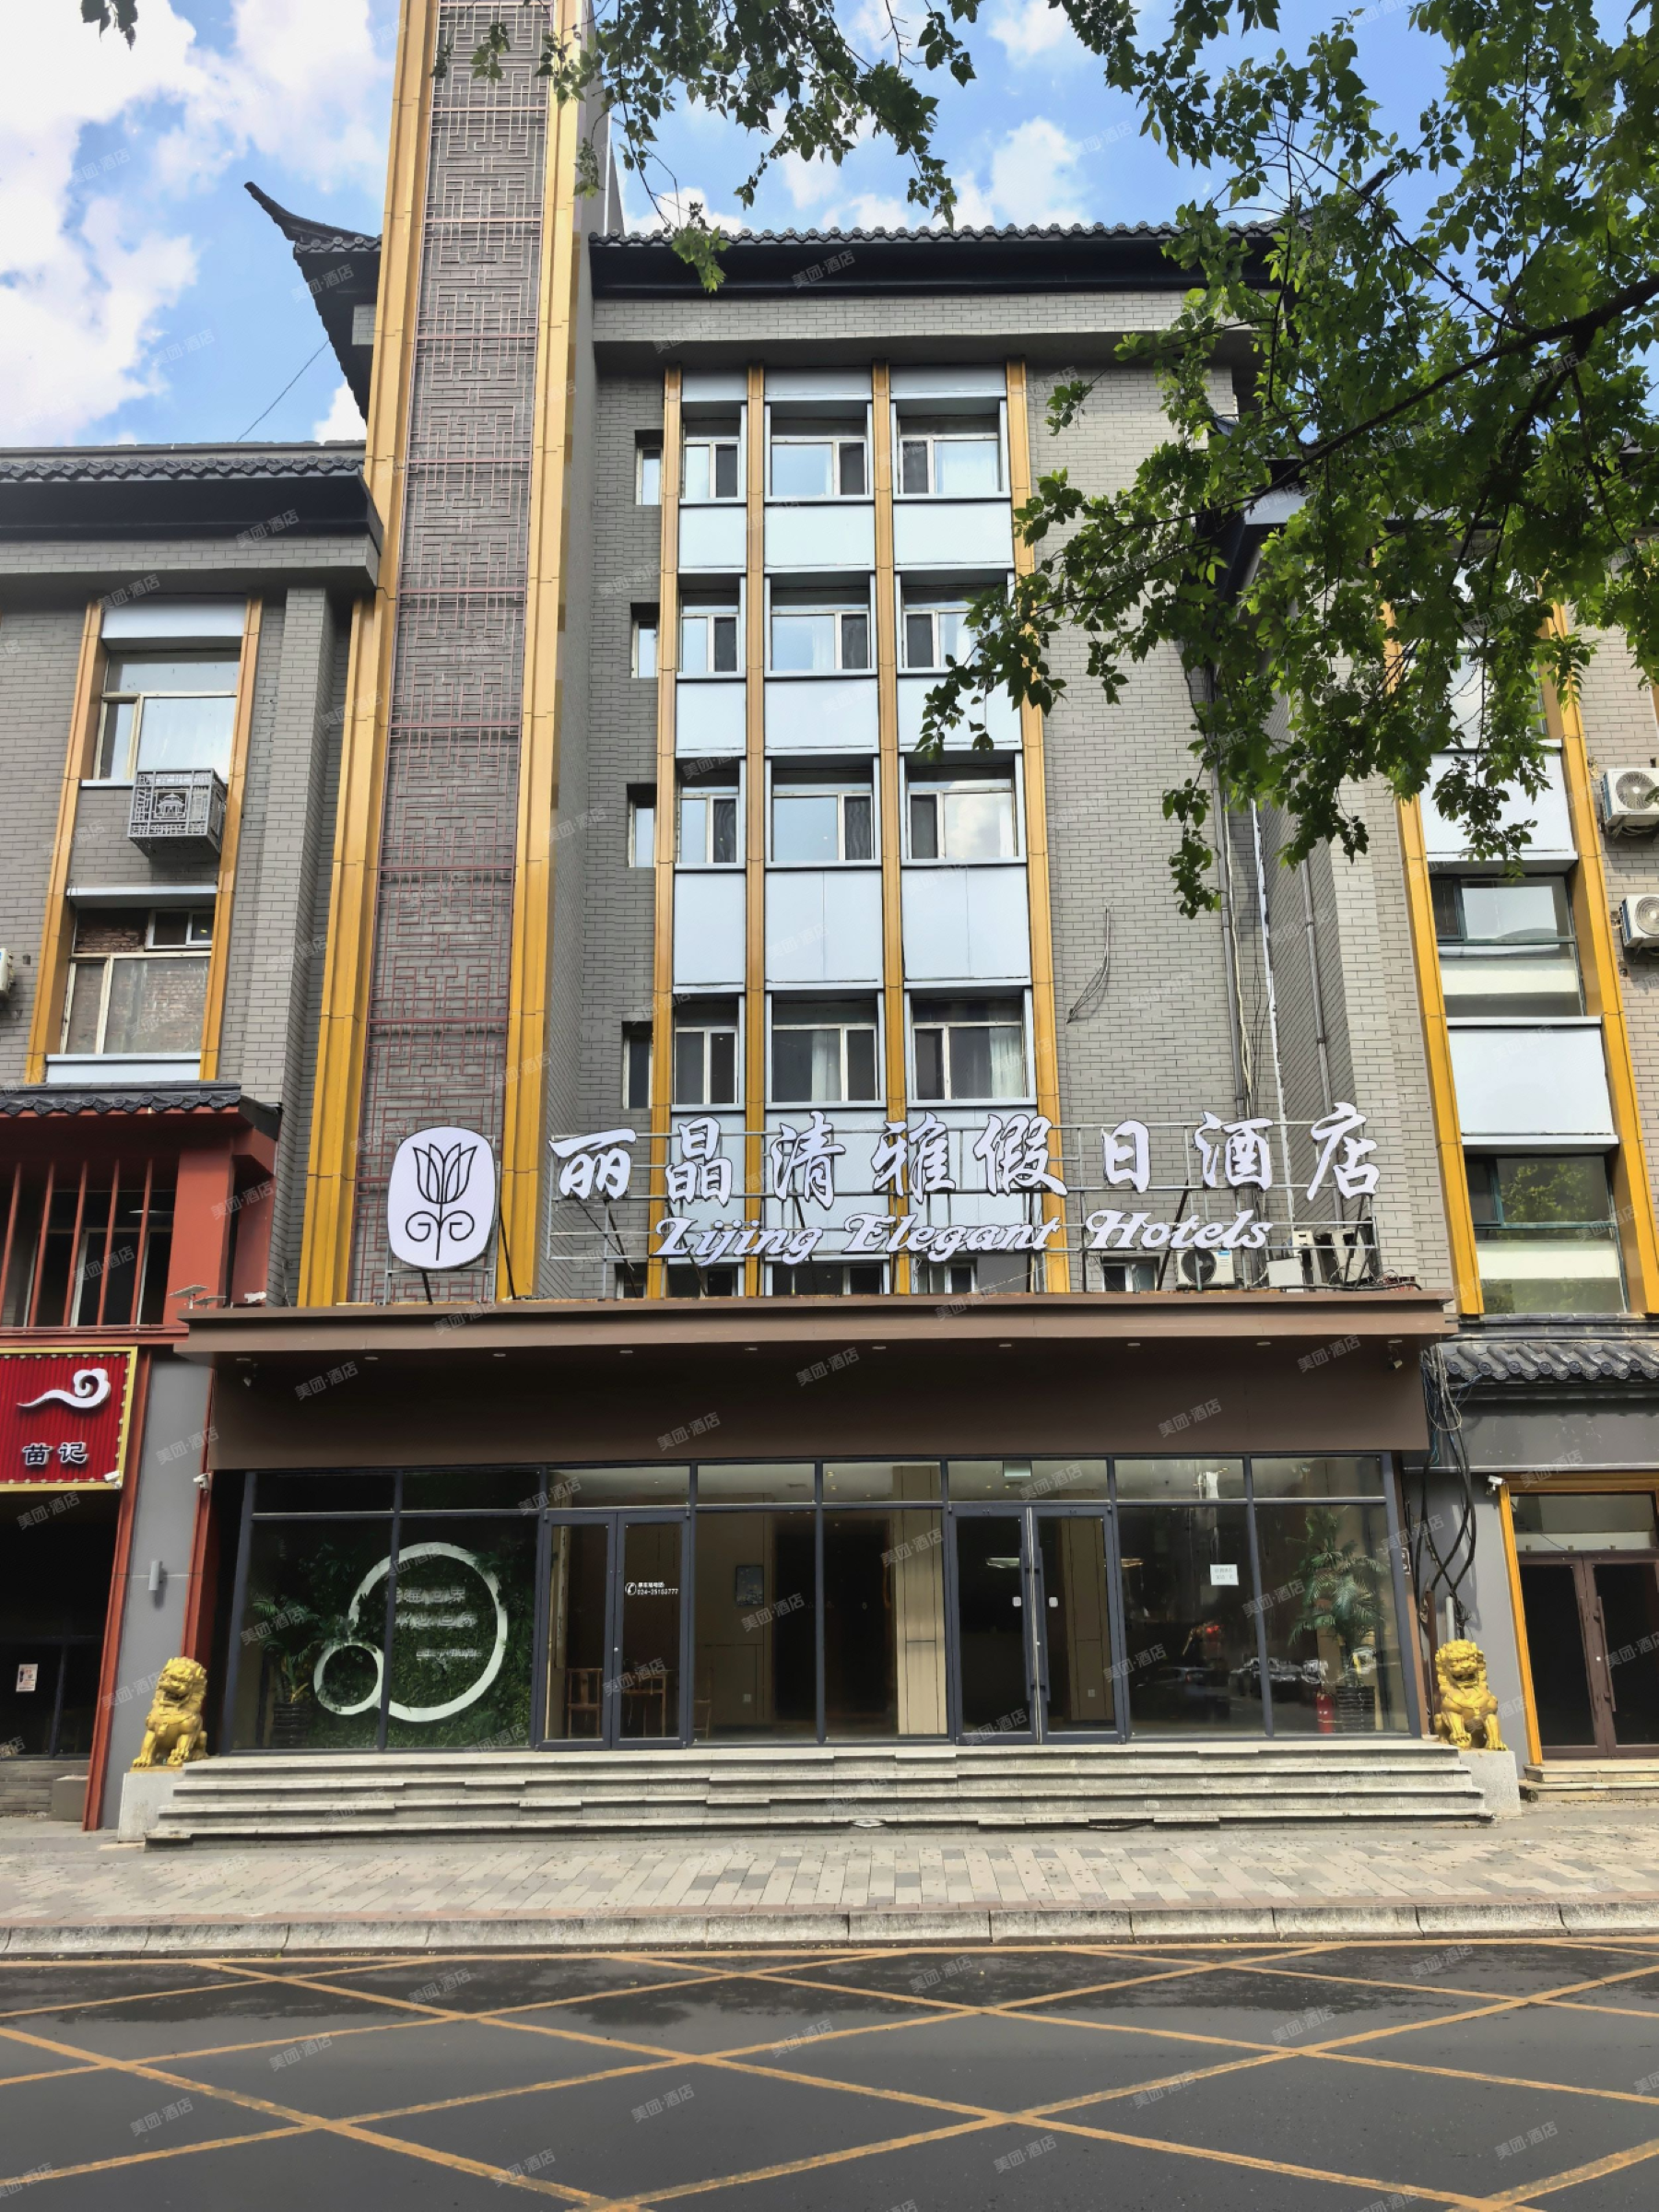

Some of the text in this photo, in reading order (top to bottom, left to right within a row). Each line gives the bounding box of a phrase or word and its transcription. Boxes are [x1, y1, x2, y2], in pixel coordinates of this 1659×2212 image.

[549, 1102, 1380, 1210] 丽晶清雅假日酒店
[653, 1209, 1273, 1266] Lijing Elegant Hotels
